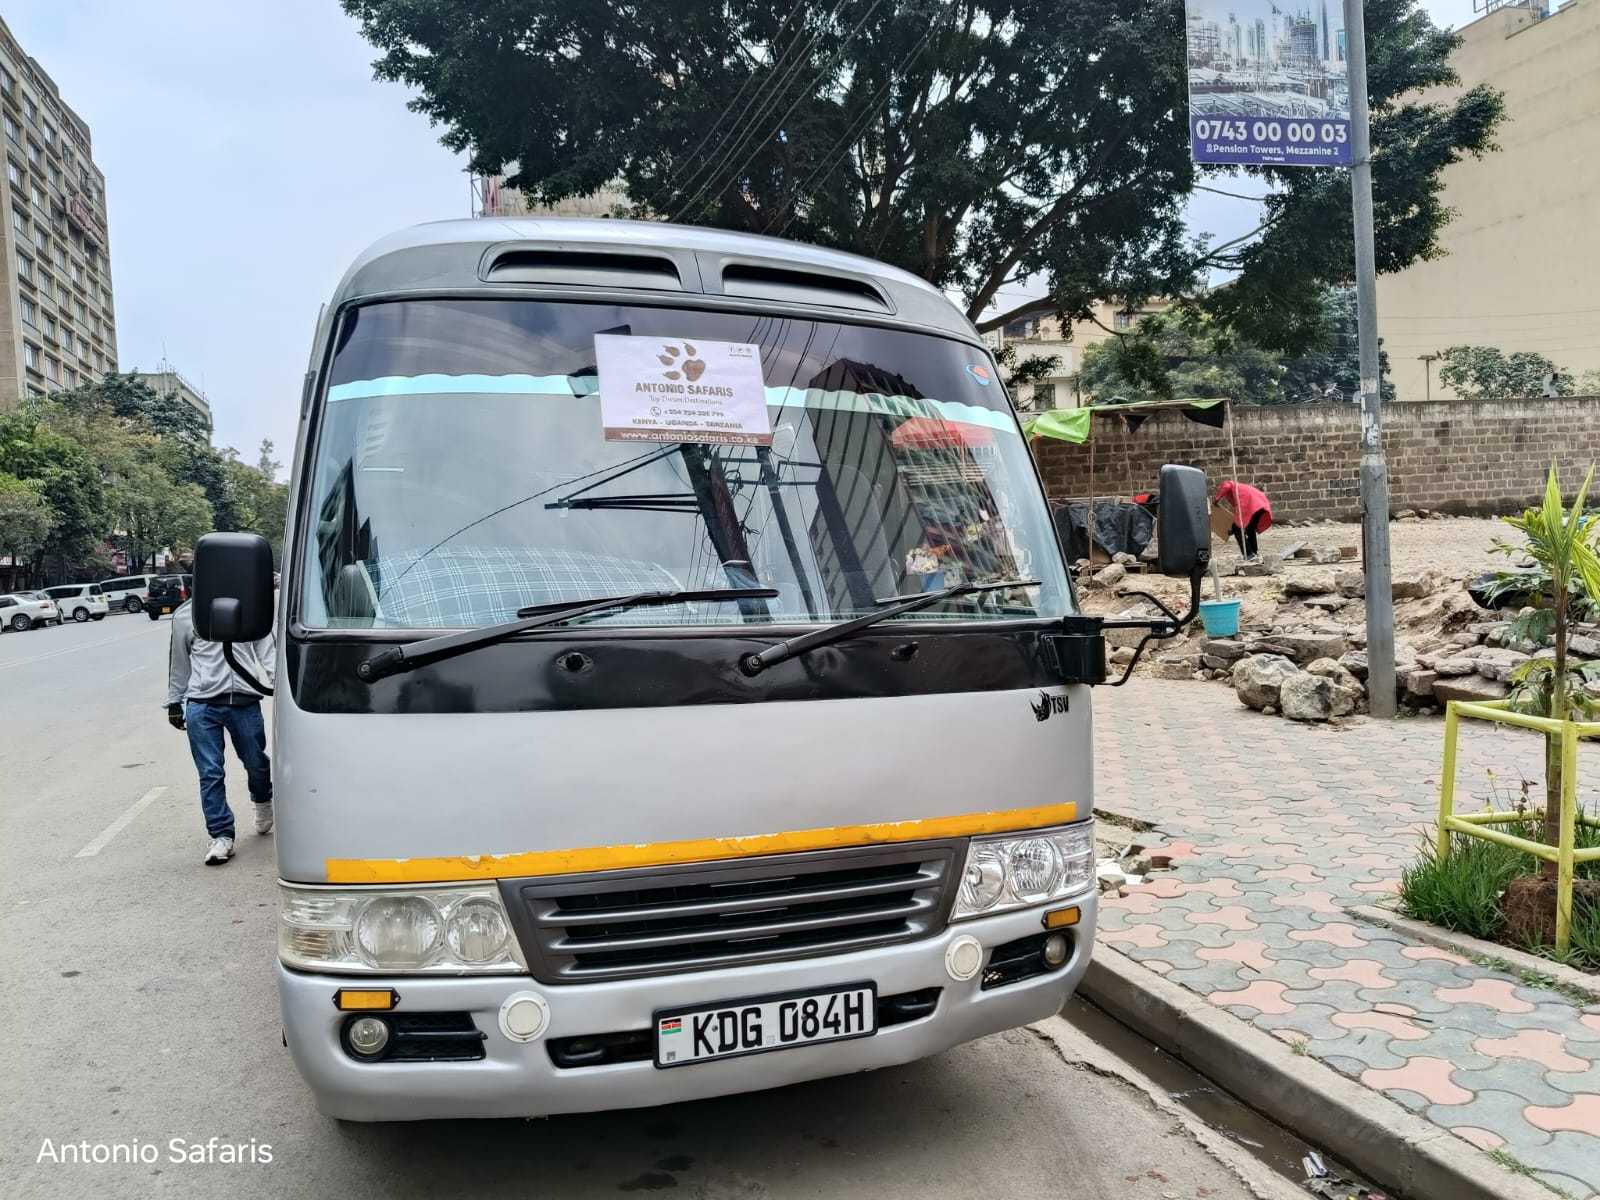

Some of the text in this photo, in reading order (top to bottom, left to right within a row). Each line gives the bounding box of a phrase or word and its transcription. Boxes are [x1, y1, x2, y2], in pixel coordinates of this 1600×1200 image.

[1196, 119, 1347, 144] 0743 00 00 03
[1213, 143, 1248, 153] Pension
[1250, 144, 1284, 155] Towers,
[1286, 145, 1332, 156] Mezzanine
[635, 382, 734, 397] ANTONIO SAFARIS
[632, 417, 658, 425] KENYA
[665, 419, 699, 427] UGANDA
[1050, 695, 1069, 714] TSV
[693, 992, 864, 1057] KDG 084H
